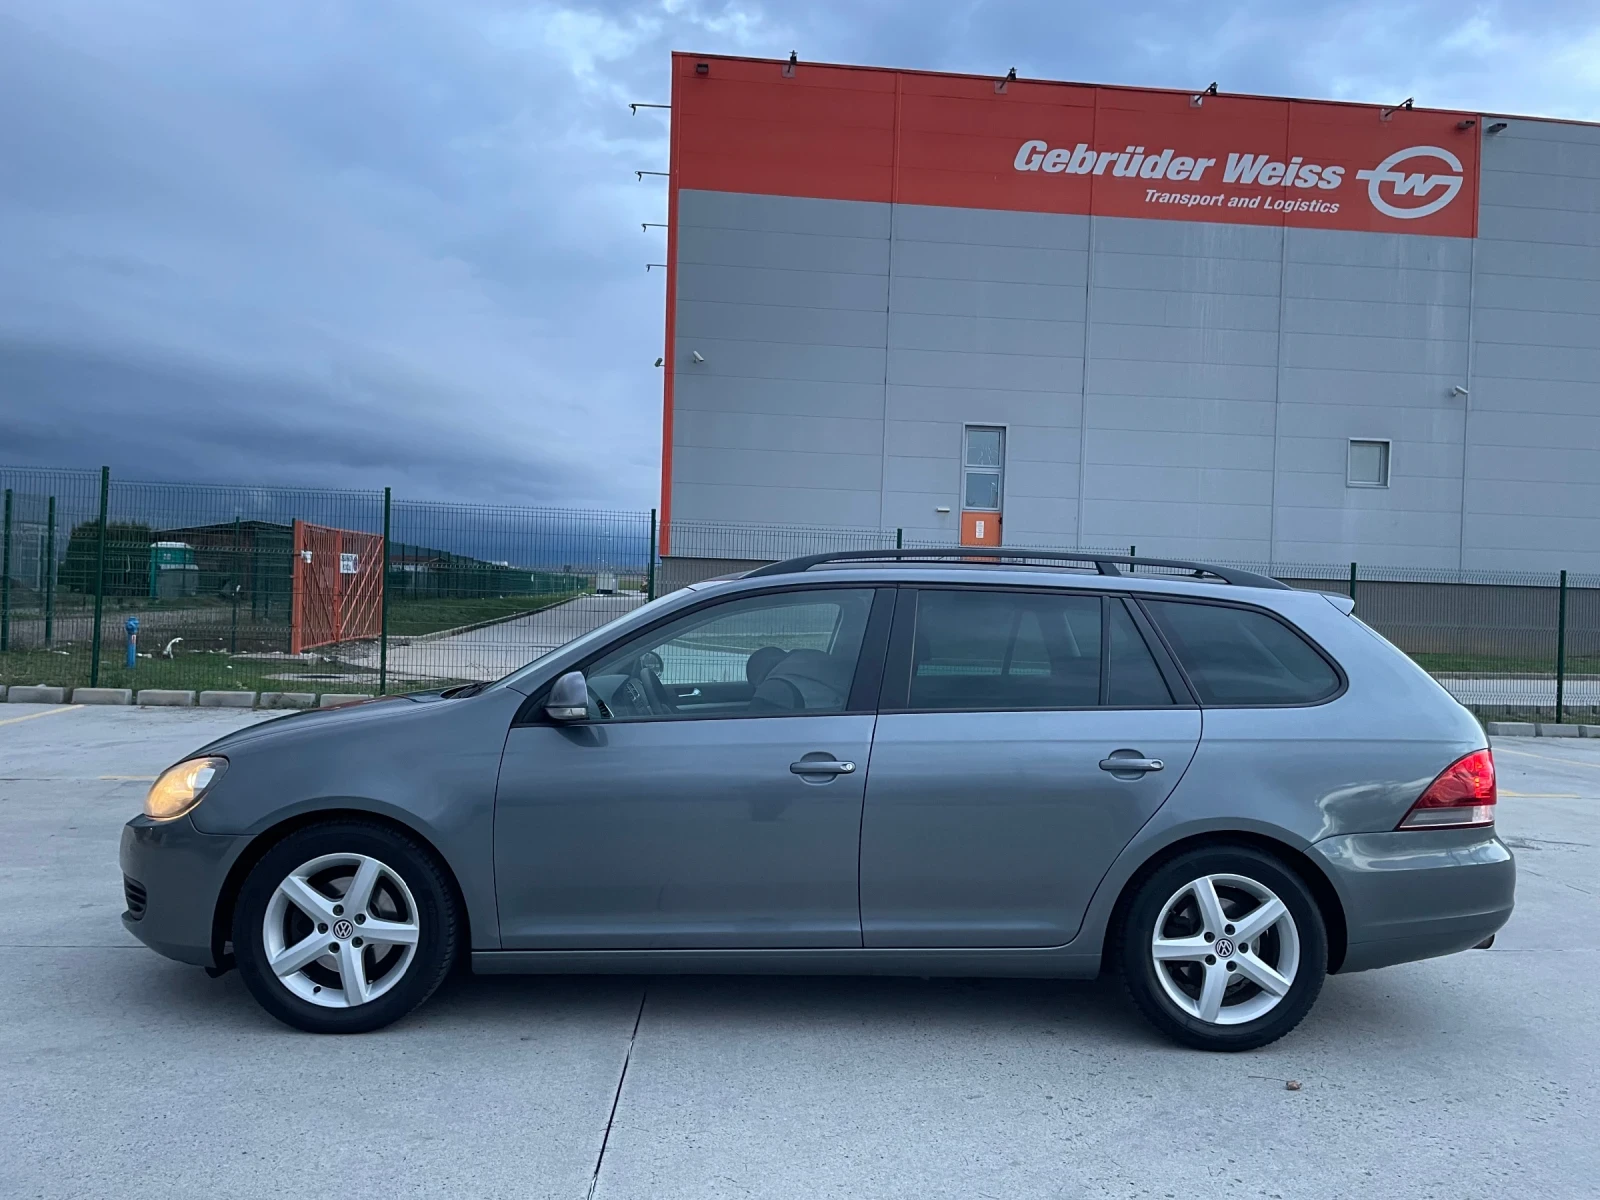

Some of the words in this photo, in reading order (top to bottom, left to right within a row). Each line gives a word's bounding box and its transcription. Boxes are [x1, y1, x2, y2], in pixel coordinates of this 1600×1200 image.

[1013, 139, 1217, 182] Gebrüder
[1222, 152, 1346, 190] Weiss
[1144, 189, 1225, 207] Transport
[1227, 195, 1262, 209] and
[1263, 196, 1341, 214] Logistics
[334, 920, 353, 939] VW
